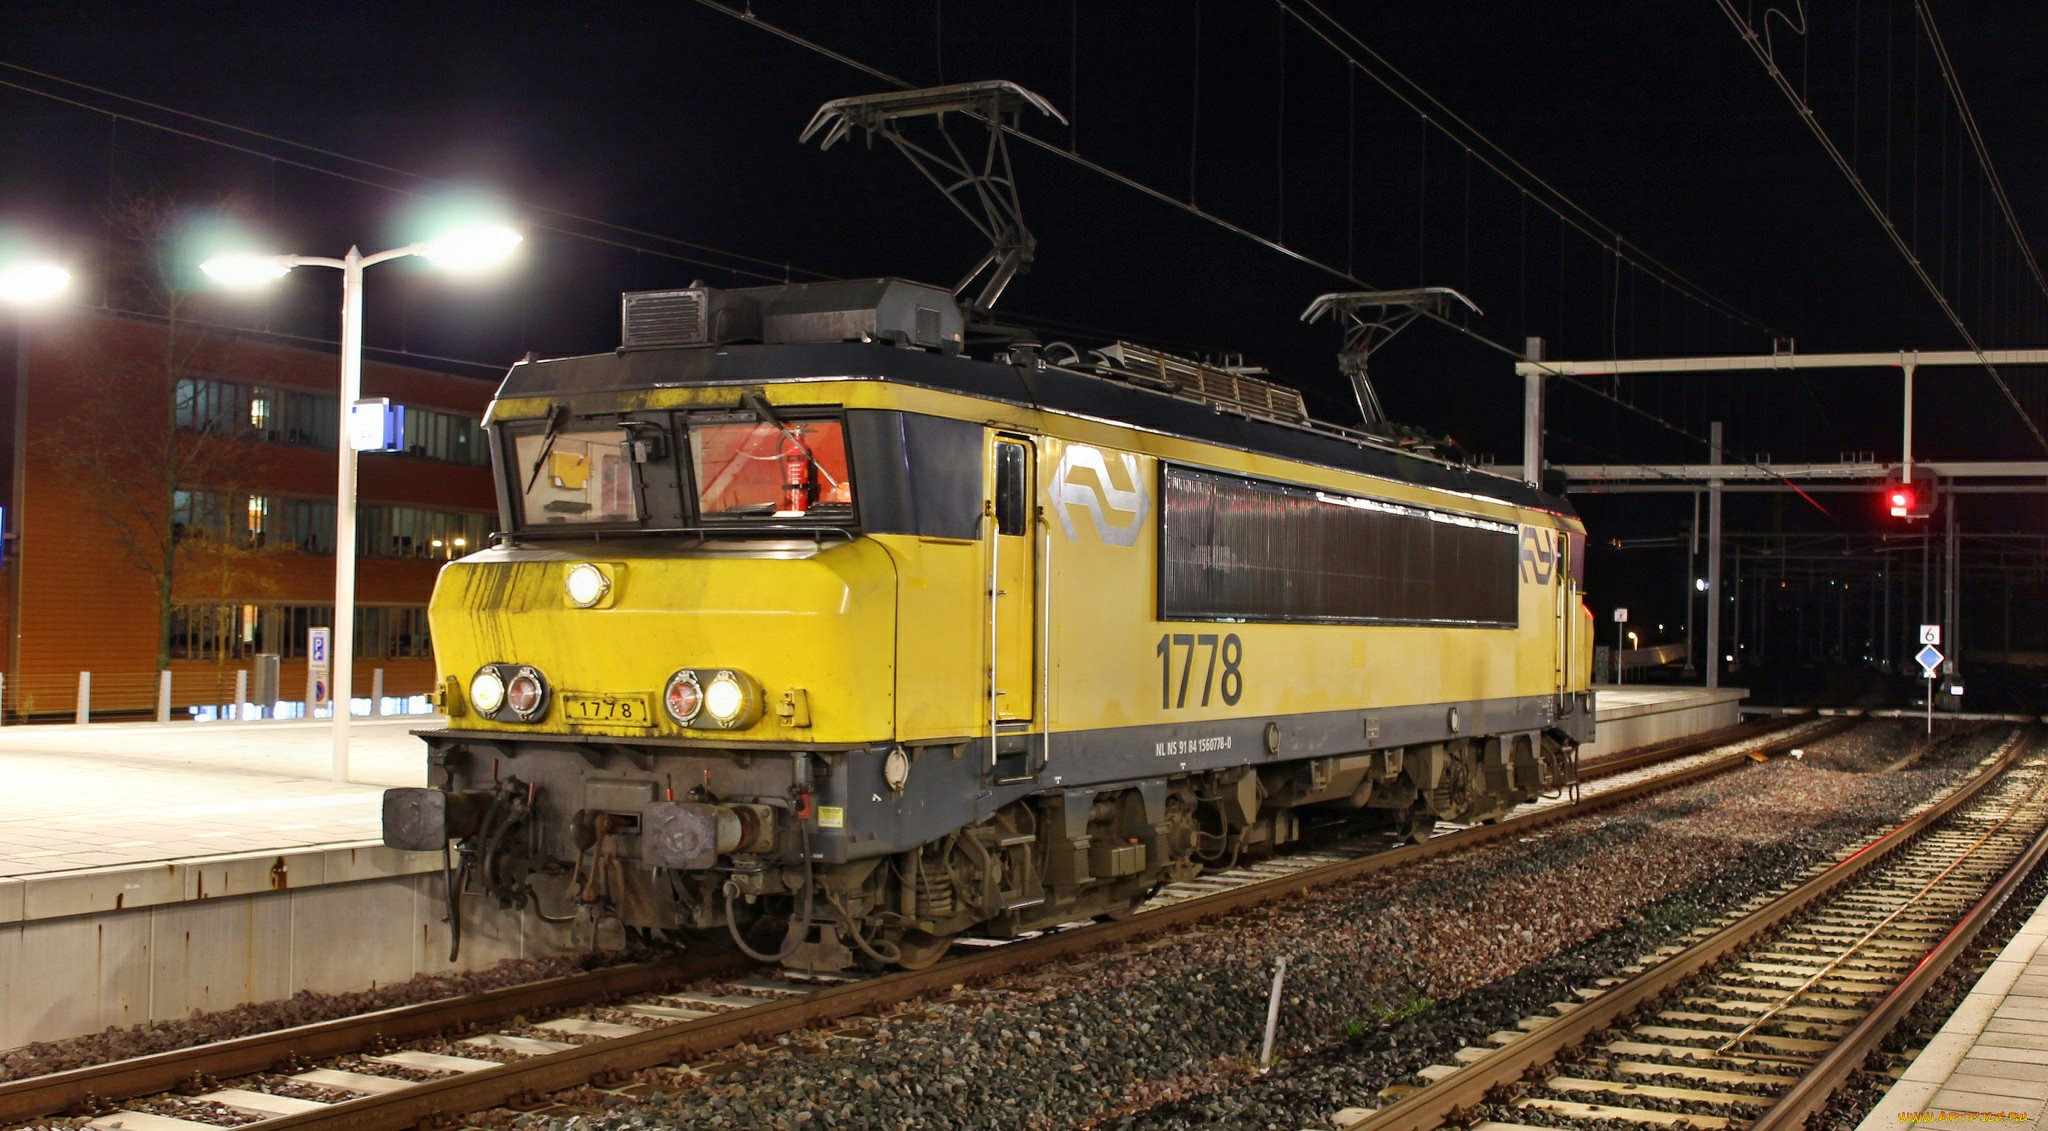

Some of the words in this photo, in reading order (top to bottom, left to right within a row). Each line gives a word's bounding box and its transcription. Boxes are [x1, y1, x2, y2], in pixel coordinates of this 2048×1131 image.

[1925, 628, 1935, 642] 6
[1157, 633, 1243, 710] 1778
[580, 702, 632, 718] 1778
[1156, 743, 1166, 757] NL
[1167, 741, 1178, 755] NS
[1179, 740, 1187, 754] 91
[1188, 740, 1197, 753] 84
[1199, 736, 1232, 752] 1560778-0
